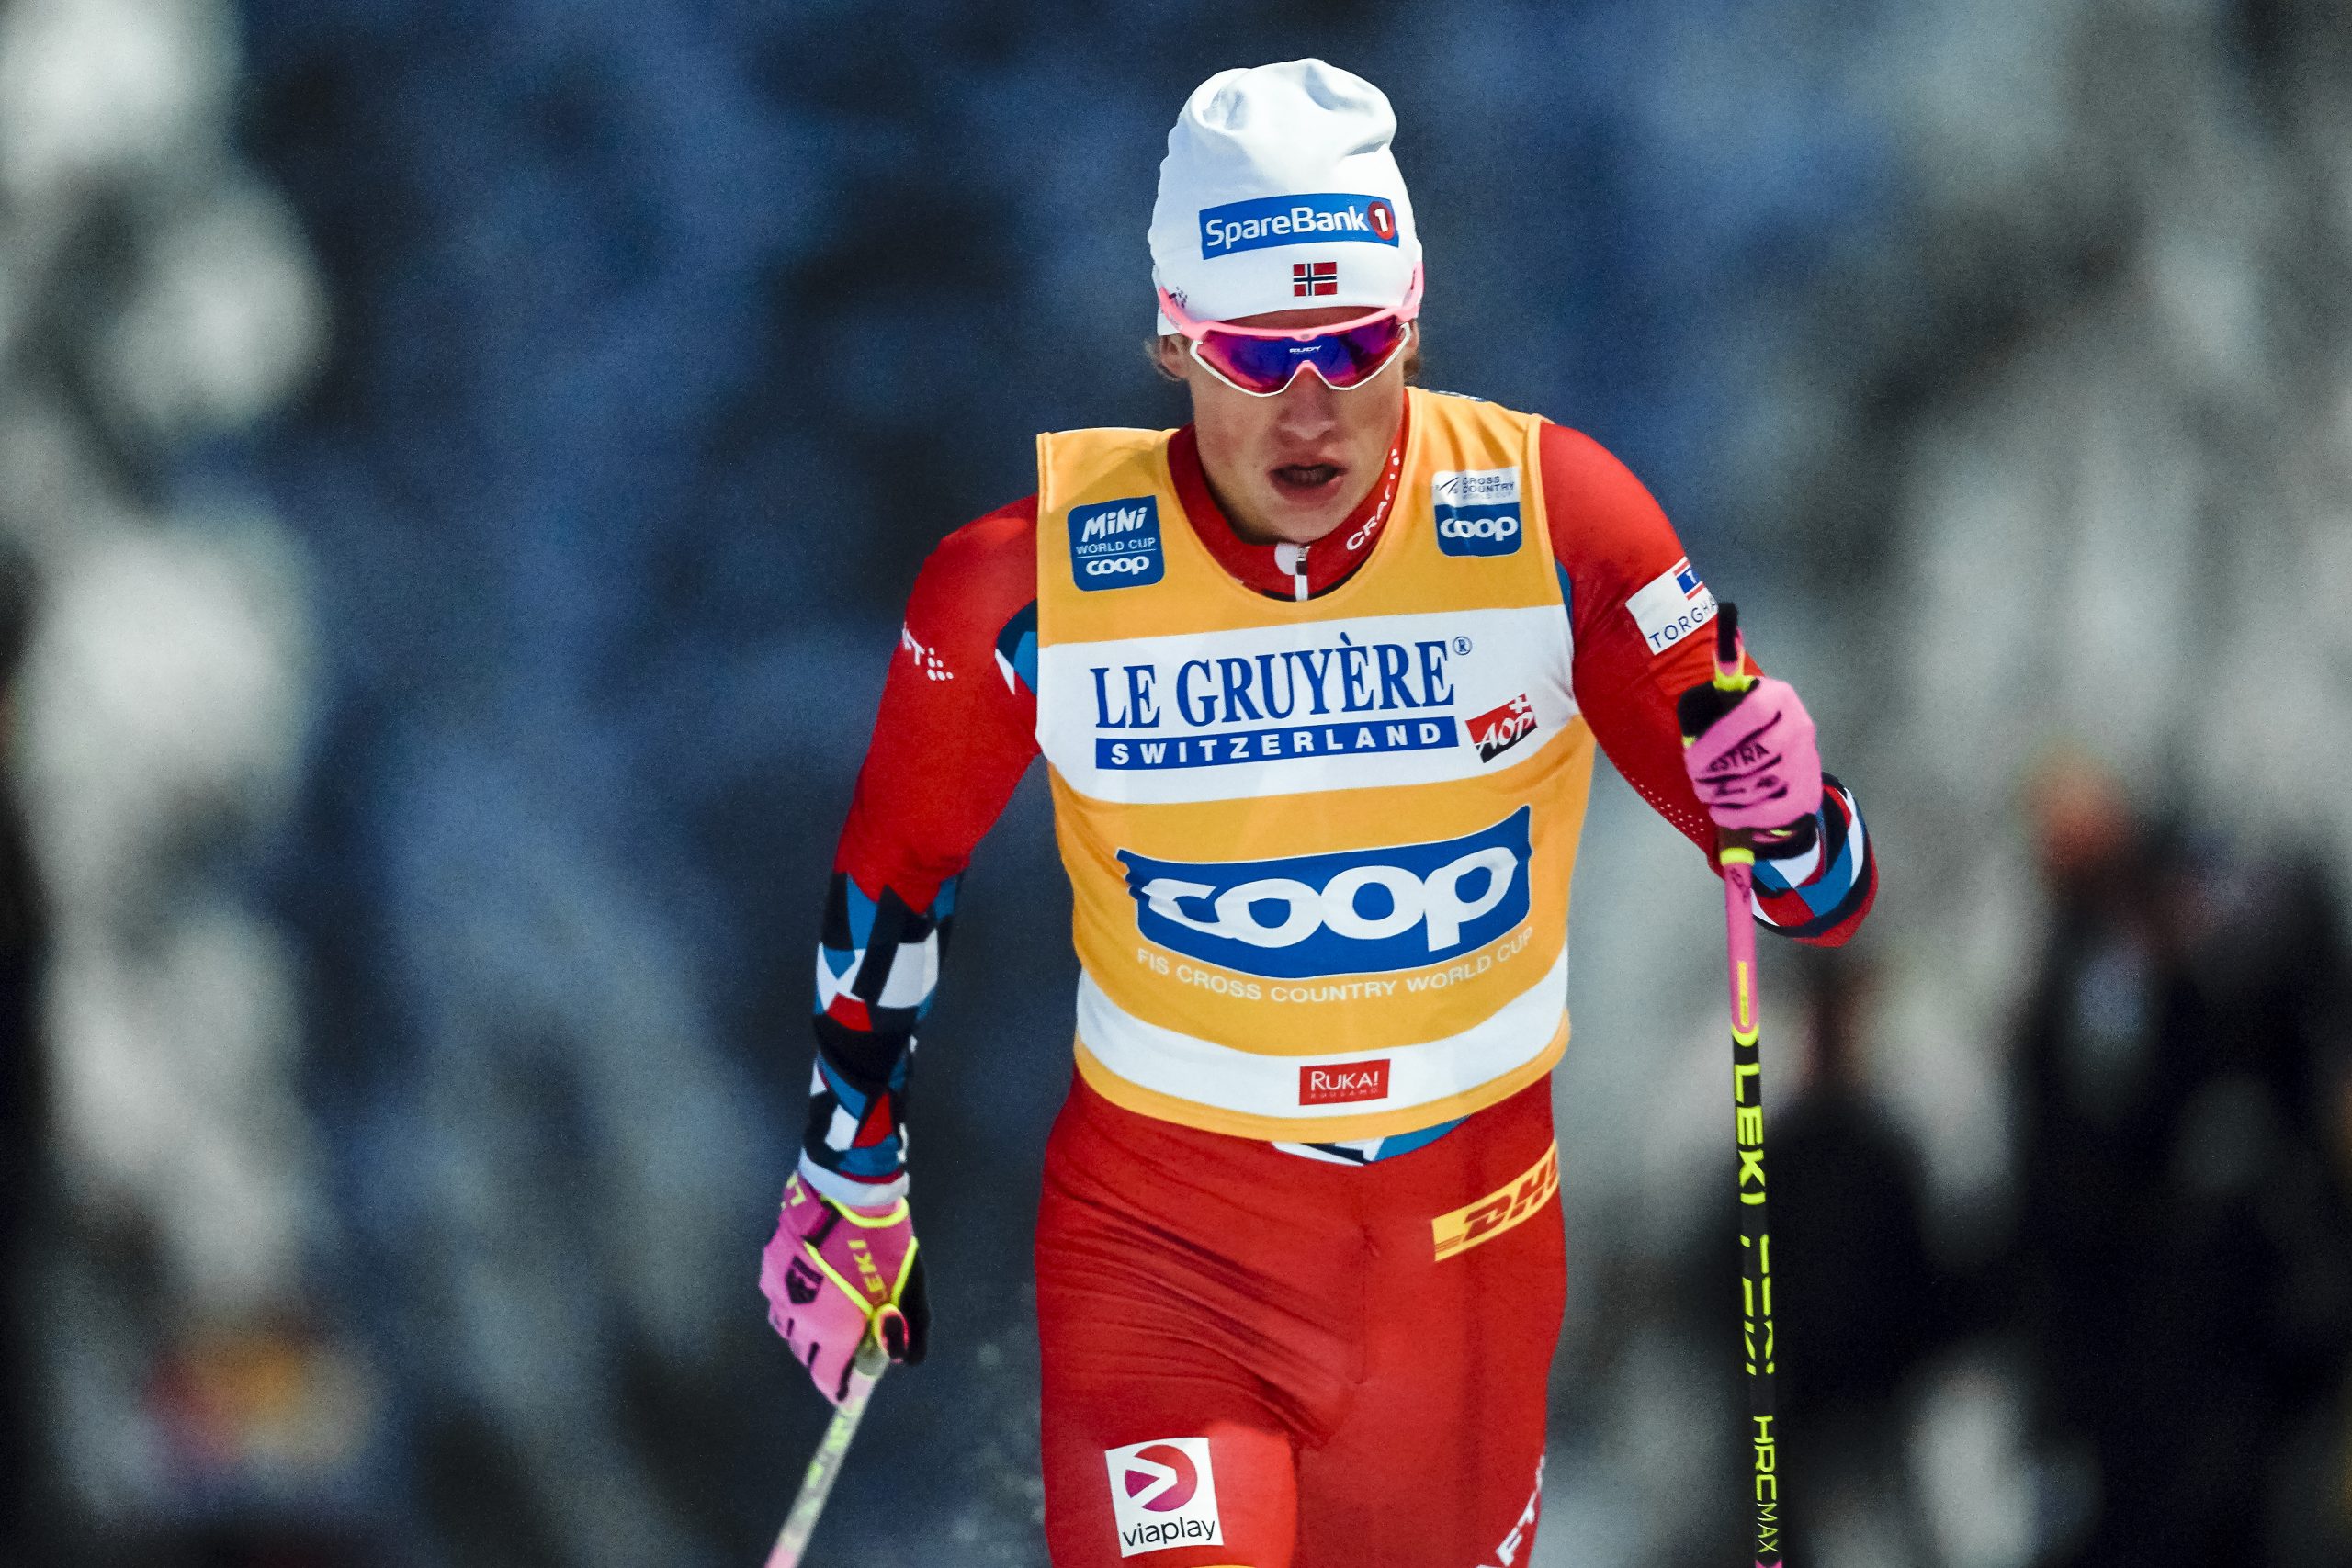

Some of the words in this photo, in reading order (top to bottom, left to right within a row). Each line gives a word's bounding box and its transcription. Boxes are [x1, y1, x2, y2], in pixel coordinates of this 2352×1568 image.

[1205, 205, 1369, 249] SpareBank
[1076, 540, 1125, 555] WORLD
[1128, 537, 1156, 549] CUP
[1440, 516, 1519, 542] coop
[1086, 556, 1150, 576] coop
[1090, 663, 1160, 728] LE
[1110, 725, 1442, 766] SWITZERLAND
[1141, 846, 1519, 953] coop
[1137, 947, 1170, 976] FIS
[1176, 964, 1262, 1001] CROSS
[1271, 980, 1397, 1004] COUNTRY
[1406, 954, 1492, 993] WORLD
[1497, 926, 1534, 963] CUP
[1734, 1062, 1767, 1206] LEKI
[1123, 1517, 1215, 1547] viaplay
